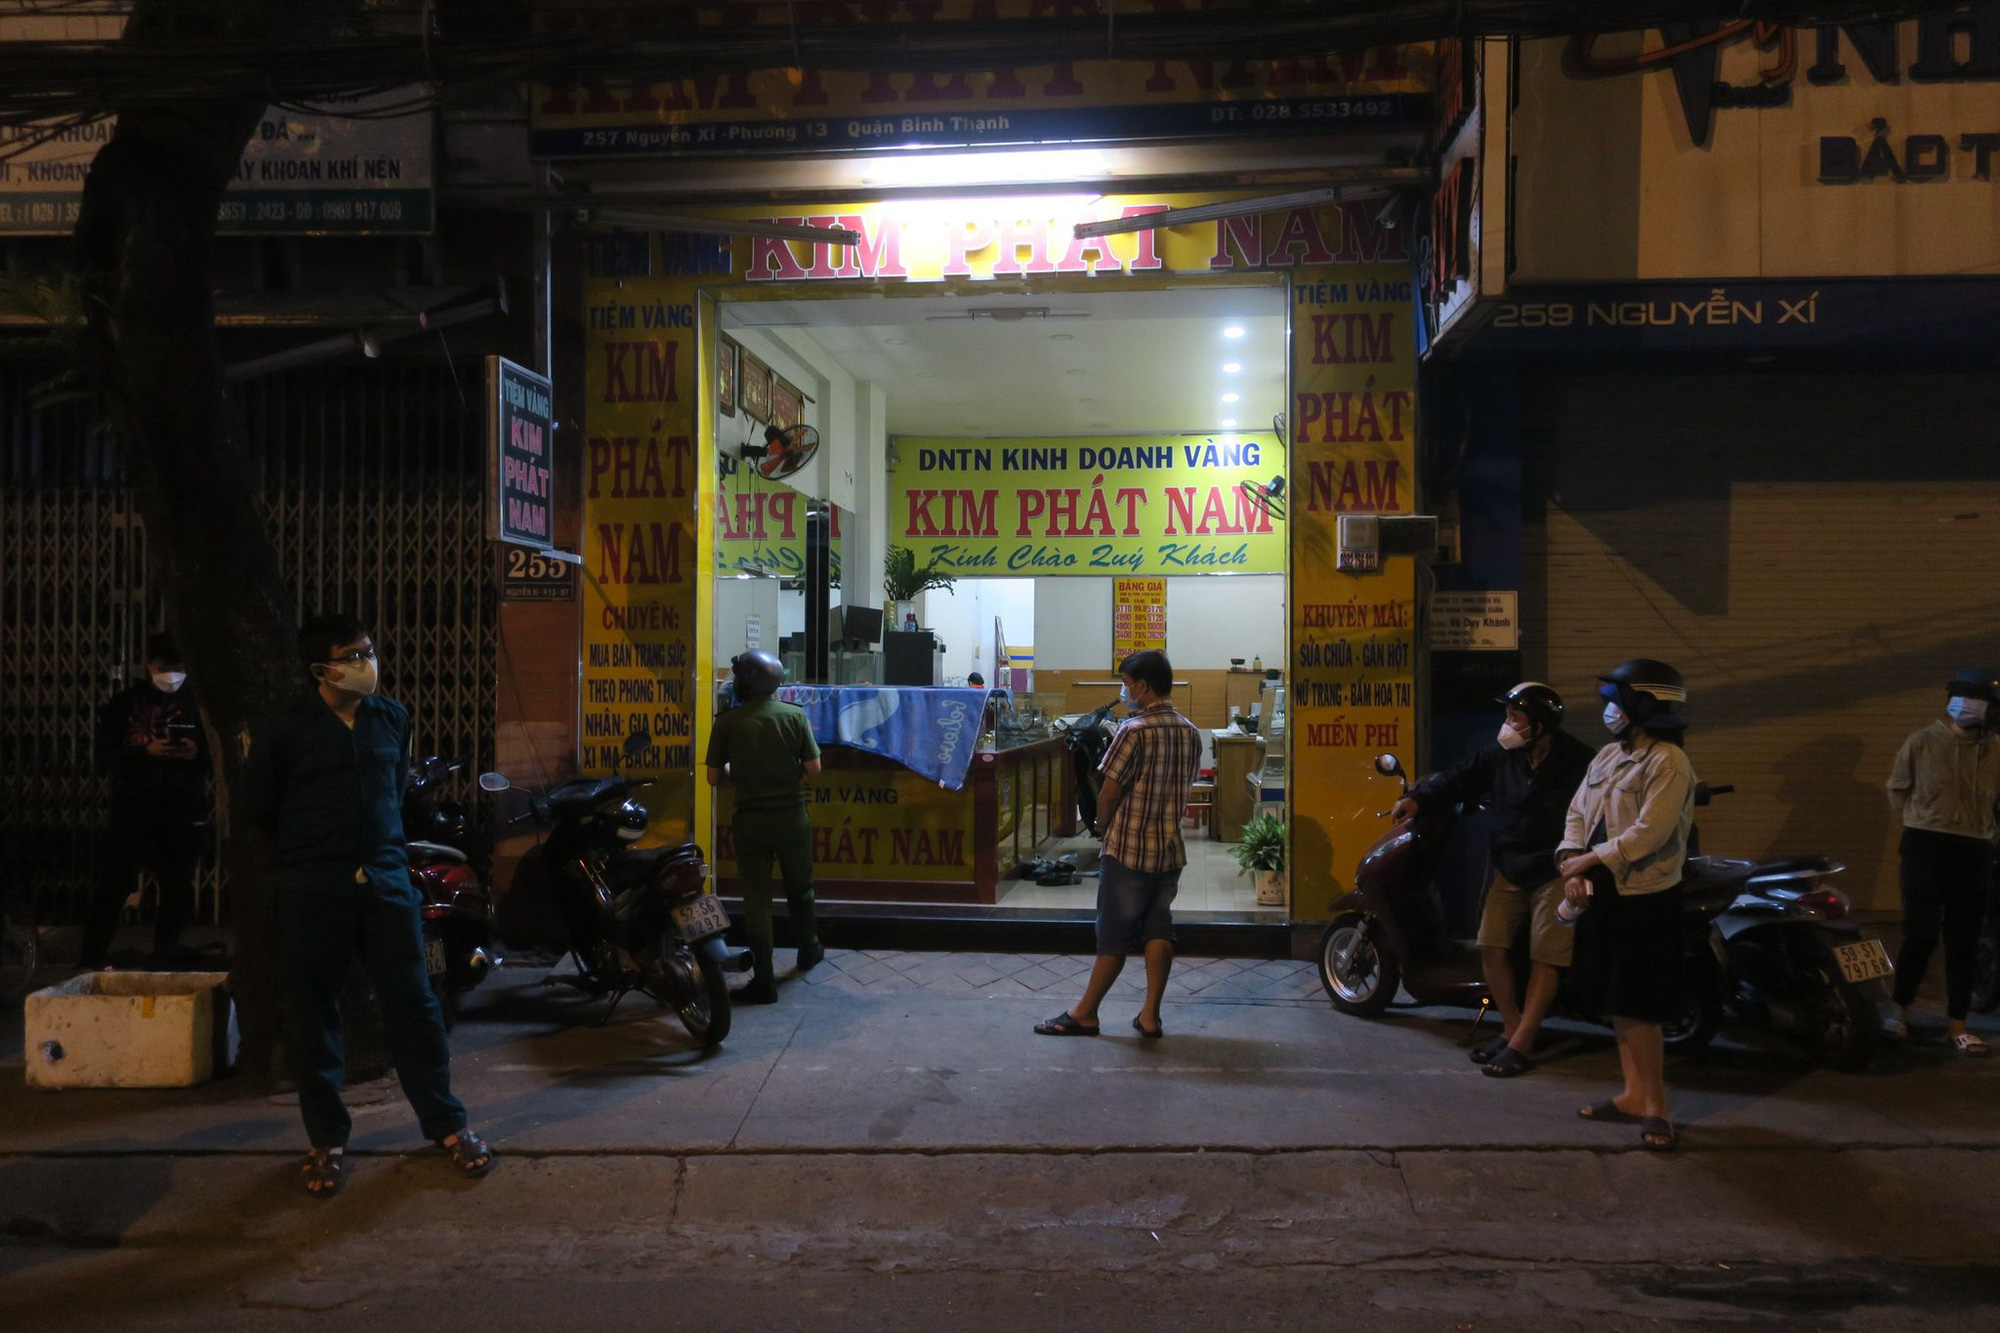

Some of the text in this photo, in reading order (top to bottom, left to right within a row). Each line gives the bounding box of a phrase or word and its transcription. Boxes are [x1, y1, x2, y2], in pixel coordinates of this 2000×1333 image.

[583, 131, 618, 147] 257
[847, 119, 895, 138] Quận
[1820, 118, 1947, 184] BẢO
[261, 159, 321, 180] KHOAN
[327, 153, 358, 179] KHÍ
[745, 214, 908, 282] KIM
[1210, 201, 1412, 268] NAM
[1295, 277, 1412, 309] TIỆM VÀNG
[1492, 289, 1821, 328] 259 NGUYỄN XÍ
[590, 297, 692, 335] TIỆM VÀNG
[1311, 312, 1394, 364] KIM
[604, 340, 680, 403] KIM
[1296, 374, 1411, 443] PHÁT
[511, 415, 543, 457] KIM
[588, 418, 692, 499] PHÁT
[918, 438, 1261, 472] DNTN KINH DOANH VÀNG
[504, 455, 549, 499] PHÁT
[1307, 460, 1400, 511] NAM
[509, 497, 546, 537] NAM
[904, 473, 1274, 538] KIM PHÁT NAM
[508, 549, 567, 579] 255
[598, 521, 682, 584] NAM
[929, 542, 1250, 572] Kính Chào Quý Khách
[1118, 579, 1163, 591] BẢNG GIÁ
[1302, 594, 1368, 628] KHUYẾN
[589, 643, 609, 667] MUA
[634, 643, 665, 667] TRANG
[588, 679, 616, 703] THEO
[619, 679, 654, 703] PHONG
[1311, 683, 1343, 707] TRANG
[1374, 683, 1393, 707] HOA
[1395, 683, 1411, 707] TAI
[654, 706, 690, 736] CÔNG
[1307, 714, 1399, 747] MIỄN PHÍ
[583, 745, 596, 769] XI
[665, 745, 690, 769] KIM
[838, 783, 899, 804] VÀNG
[812, 816, 966, 867] HÁT NAM
